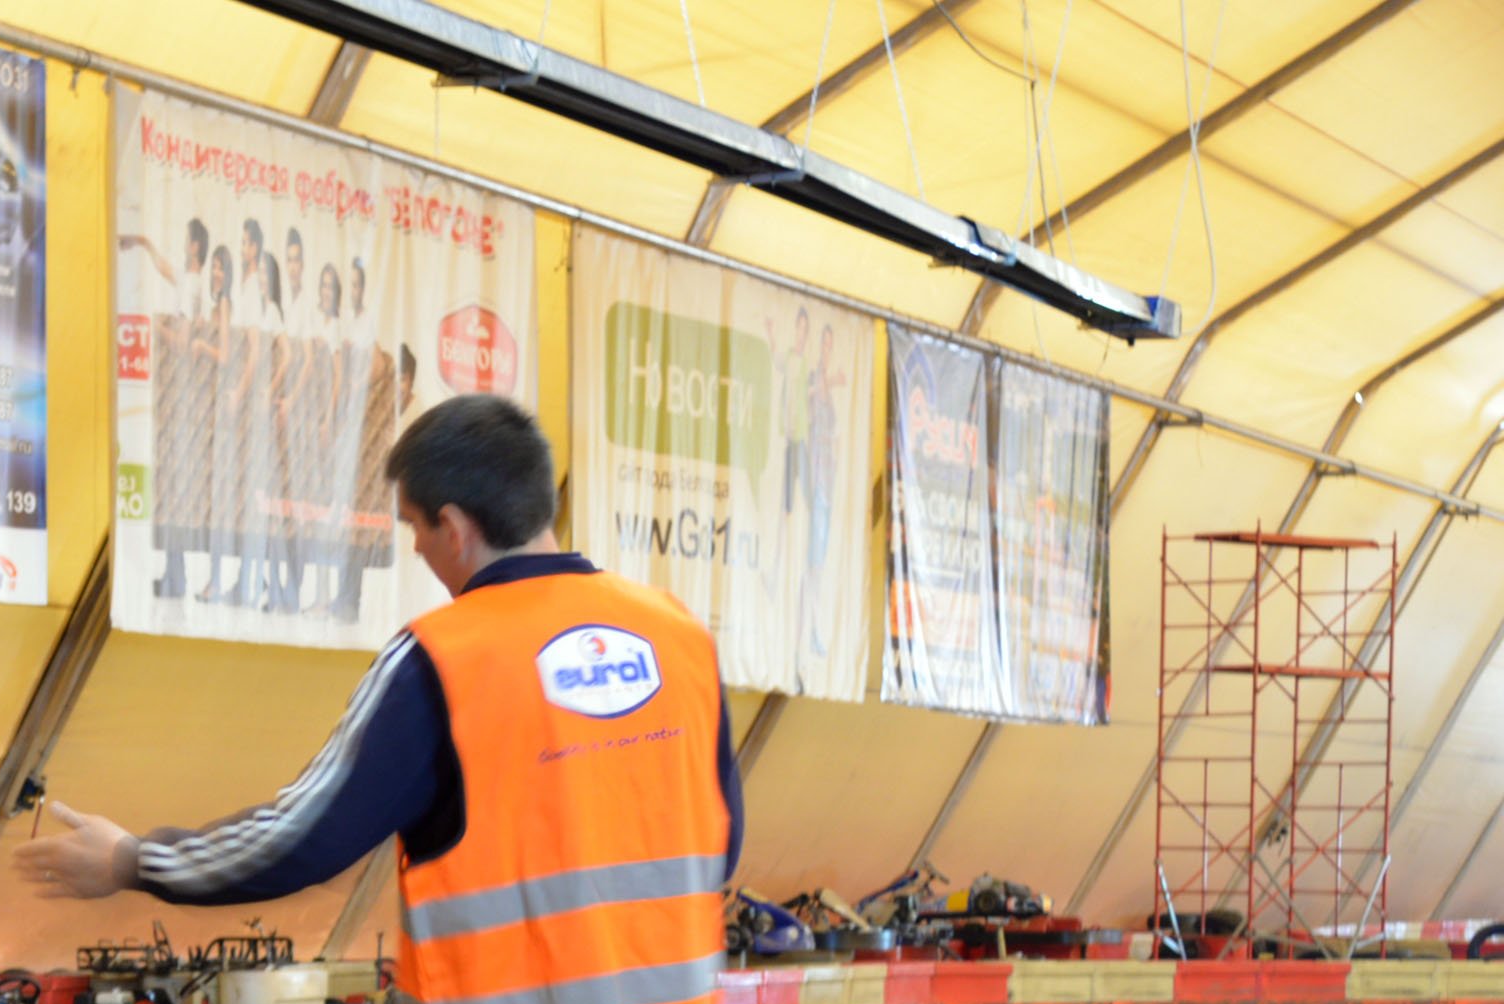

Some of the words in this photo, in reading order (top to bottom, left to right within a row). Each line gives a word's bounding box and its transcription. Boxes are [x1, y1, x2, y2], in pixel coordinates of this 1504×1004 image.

[141, 117, 291, 195] Кондитерская
[7, 488, 37, 514] 139
[554, 651, 651, 692] eurol
